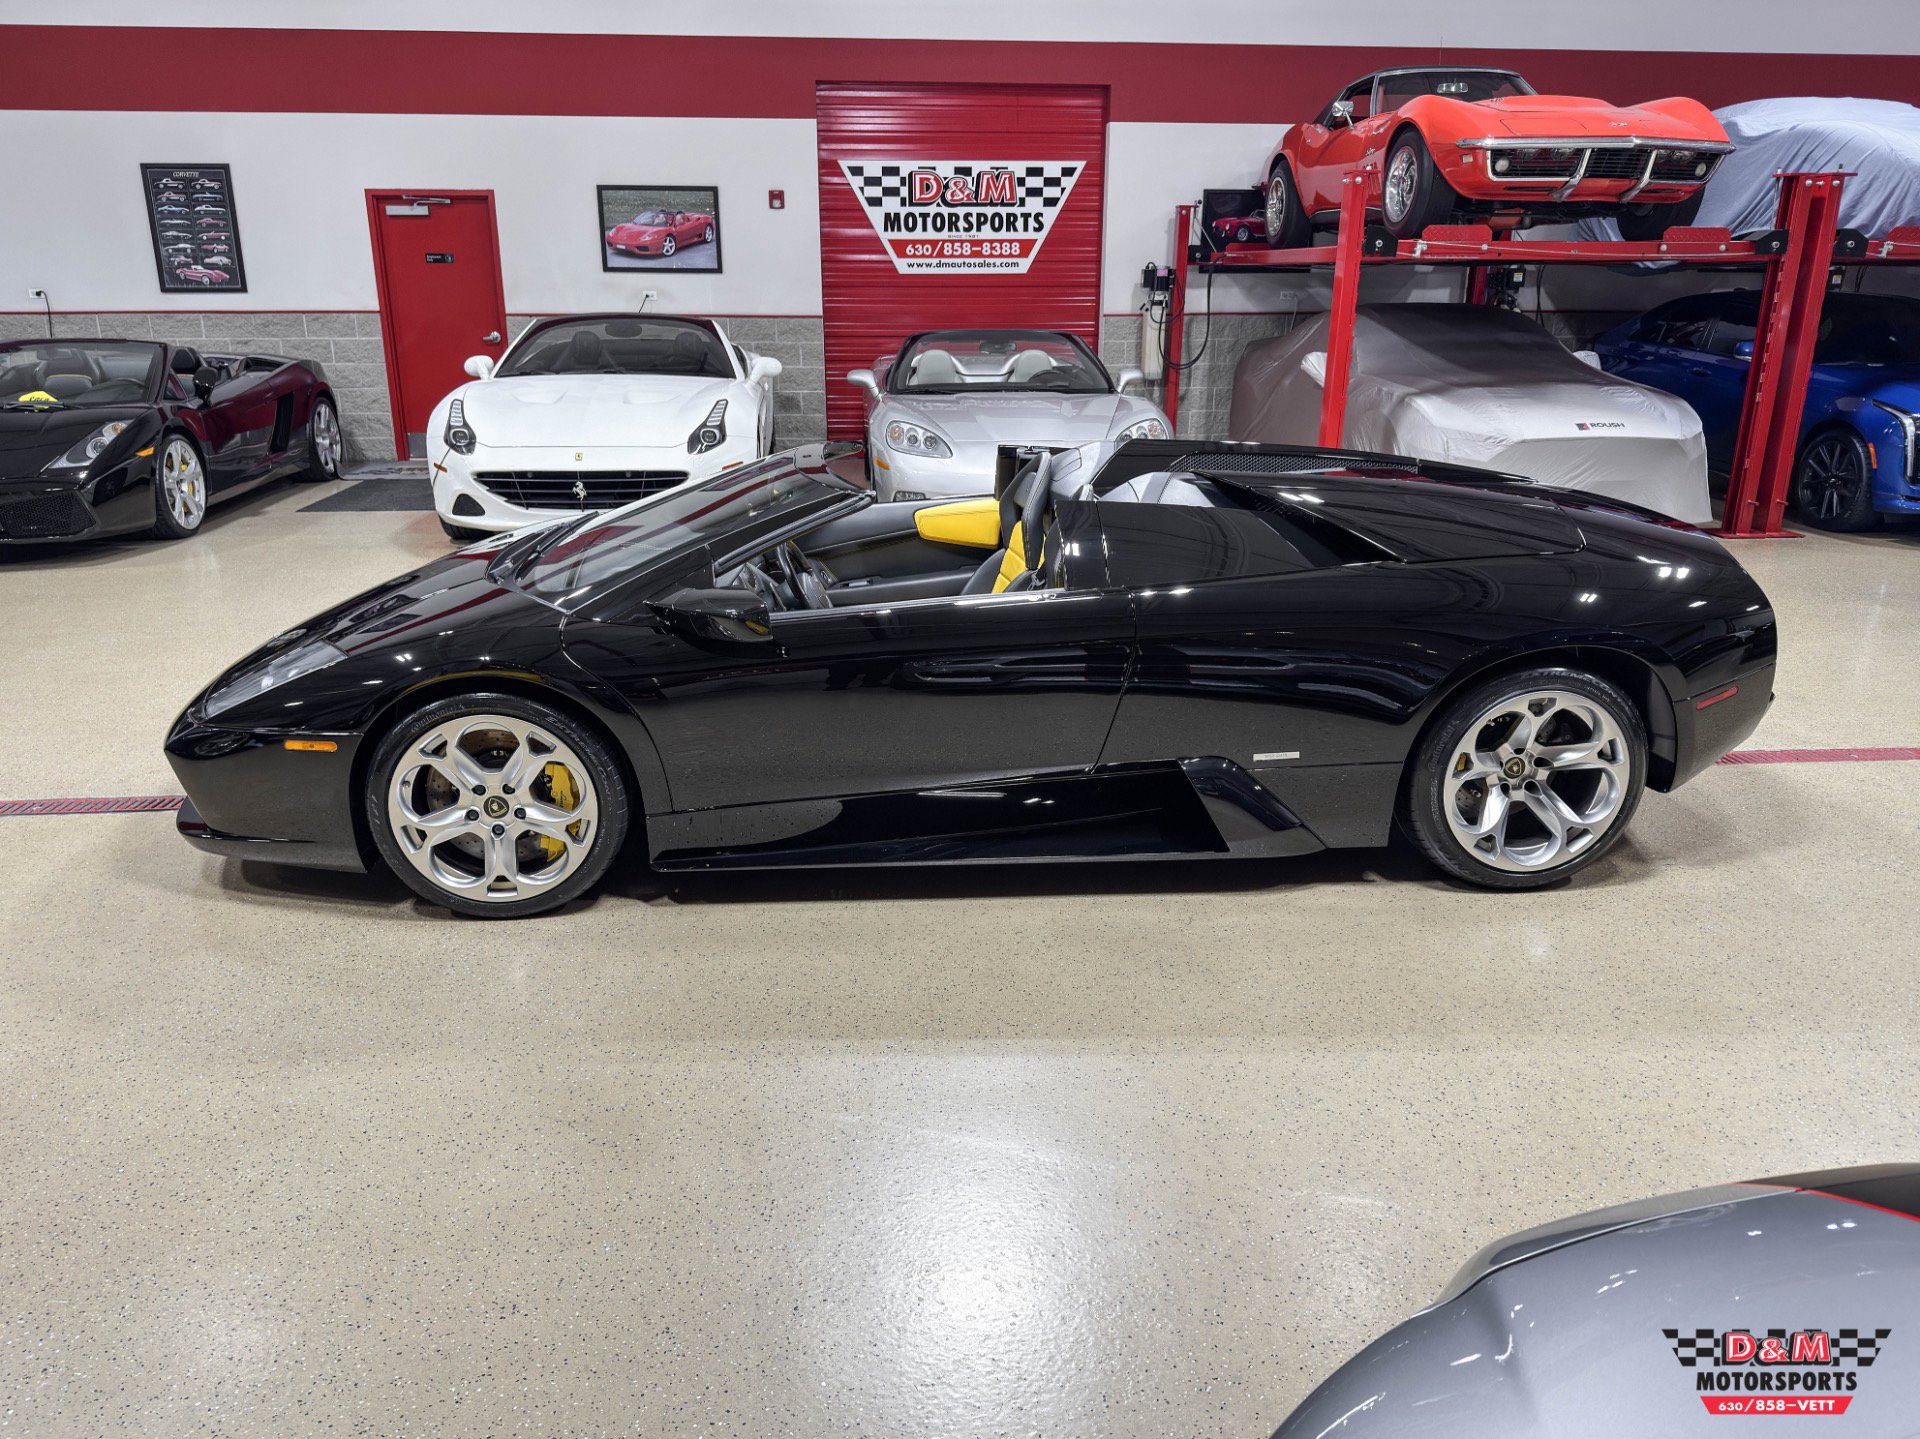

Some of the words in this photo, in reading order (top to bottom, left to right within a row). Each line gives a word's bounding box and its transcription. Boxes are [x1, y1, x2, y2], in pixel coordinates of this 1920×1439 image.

[909, 170, 1018, 207] D&M
[883, 211, 1045, 233] MOTORSPORTS
[905, 242, 1021, 257] 630/858-8388
[906, 260, 1020, 269] www.dmautosales.com
